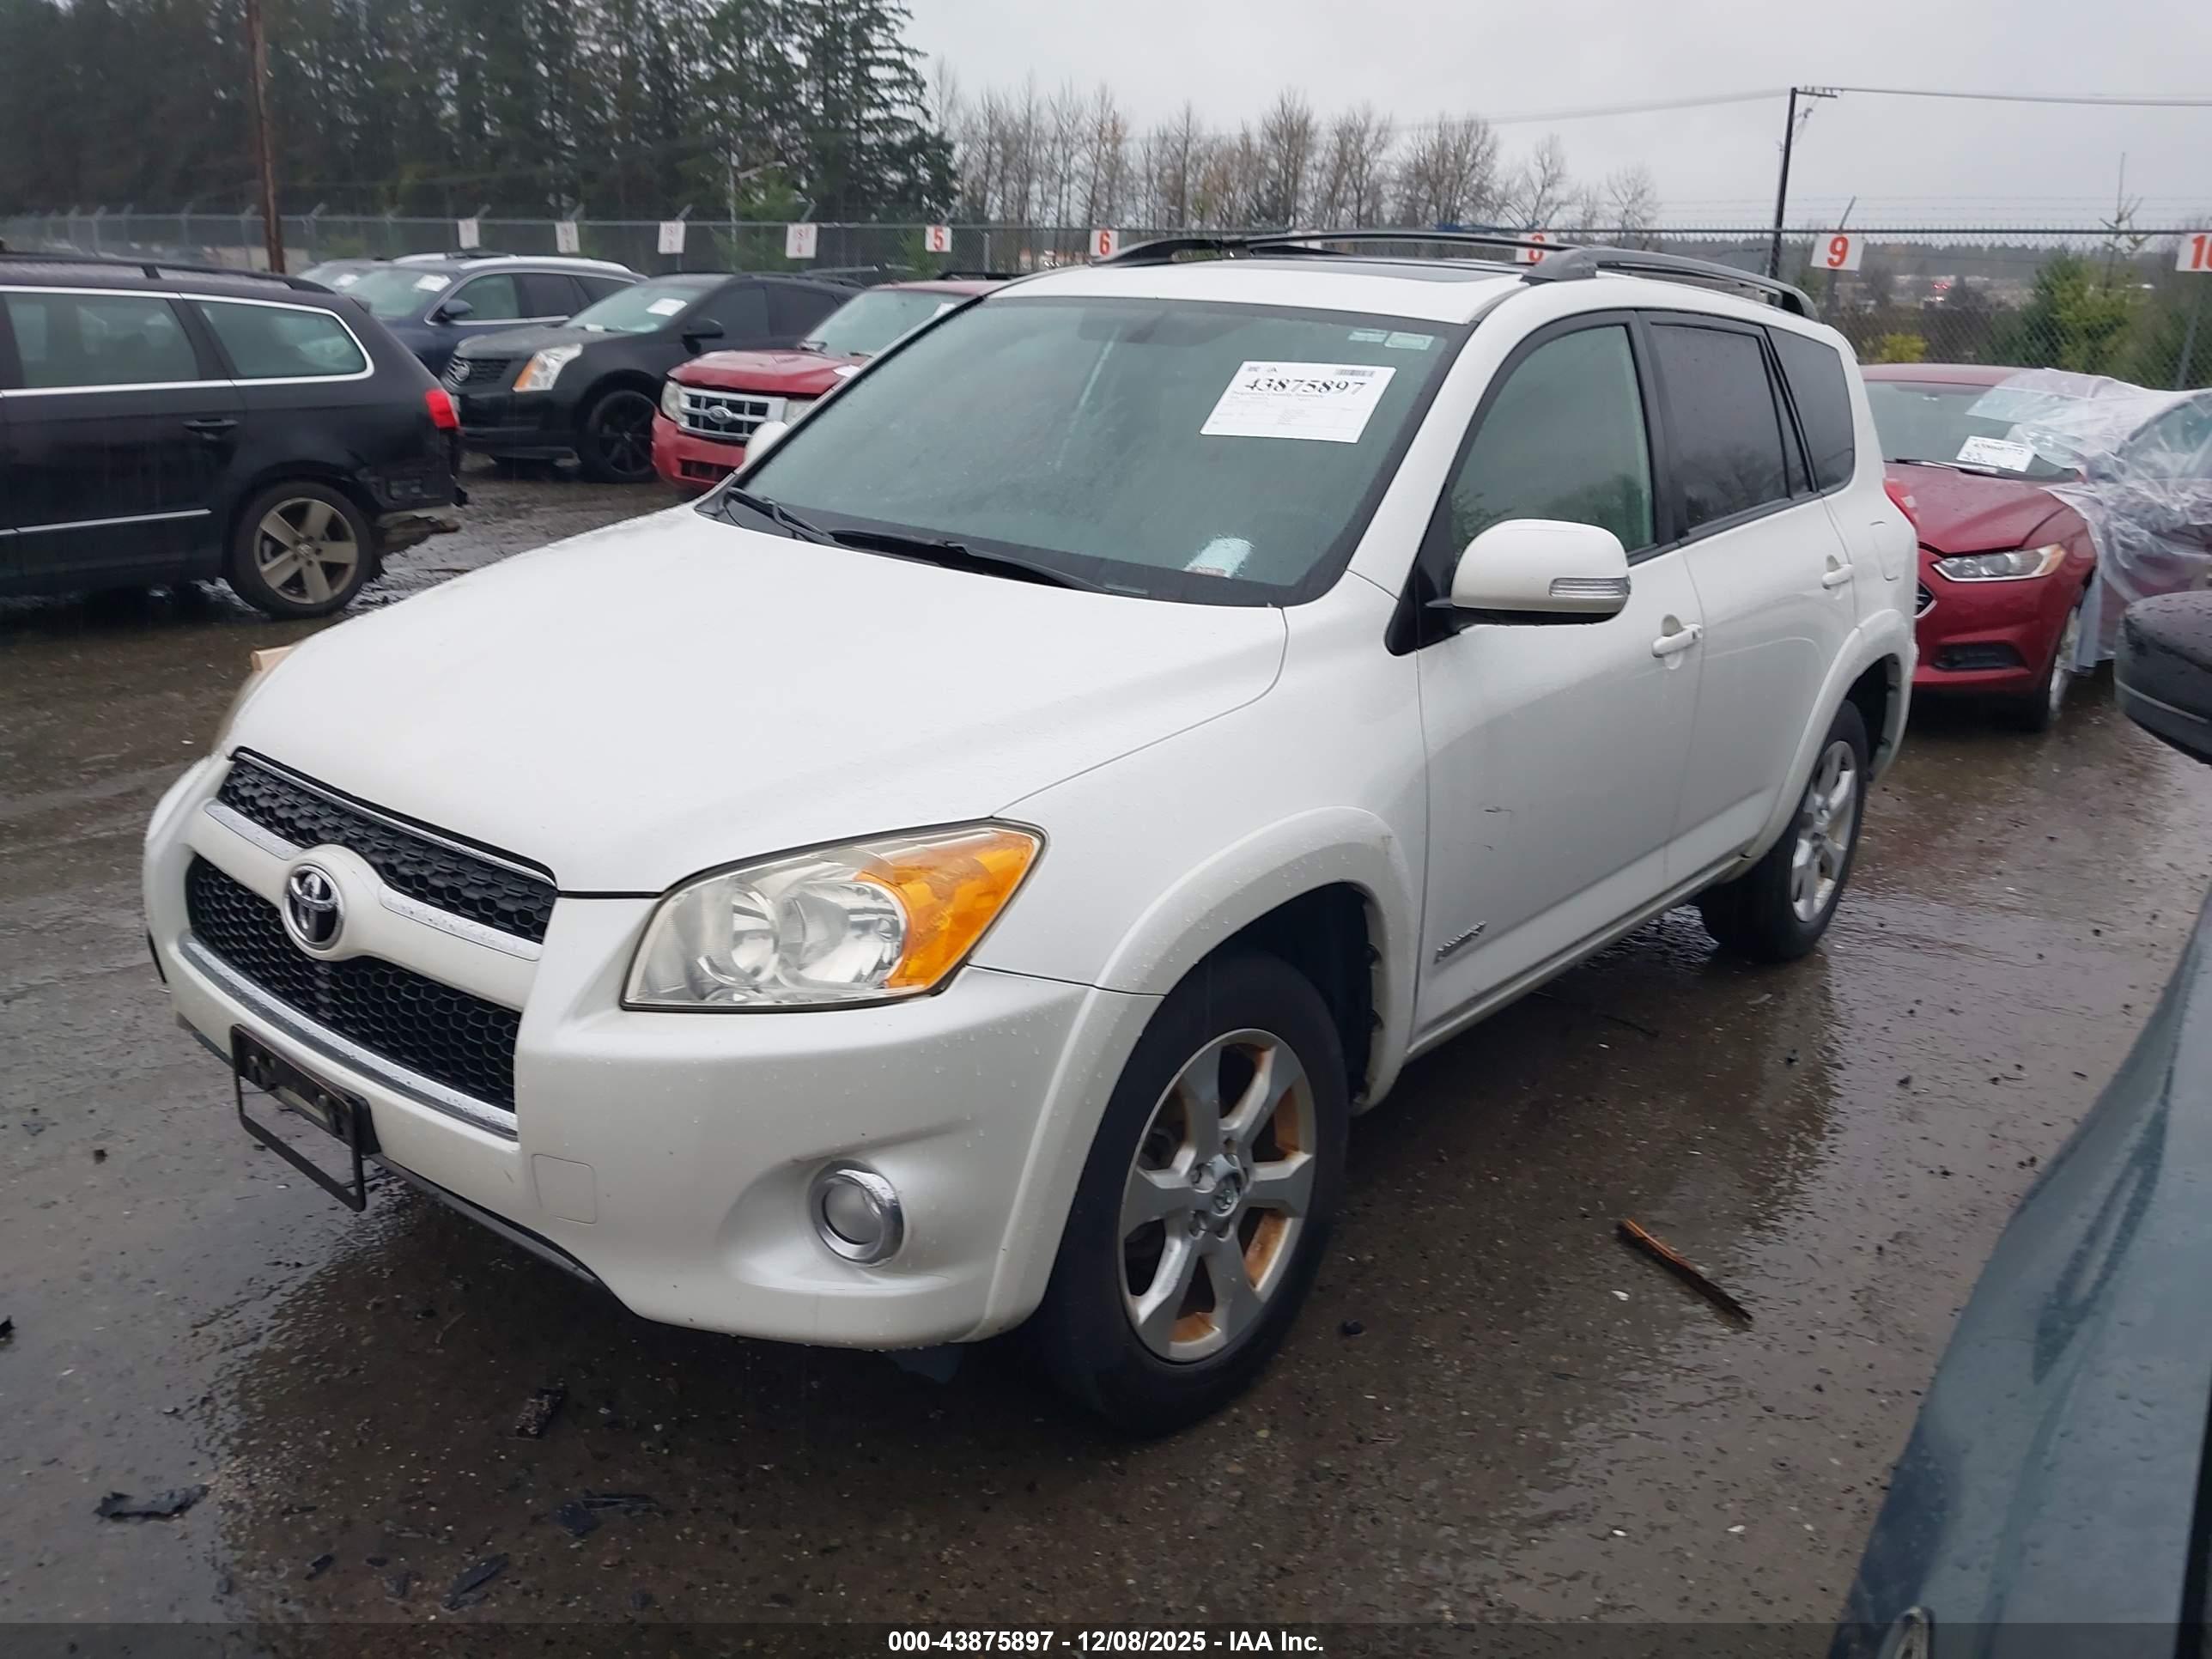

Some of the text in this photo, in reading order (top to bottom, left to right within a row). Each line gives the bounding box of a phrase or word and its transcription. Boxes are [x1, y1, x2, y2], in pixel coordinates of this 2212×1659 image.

[933, 228, 944, 250] 5
[1098, 230, 1112, 255] 6
[1827, 235, 1849, 268] 9
[1244, 377, 1367, 396] 43875897
